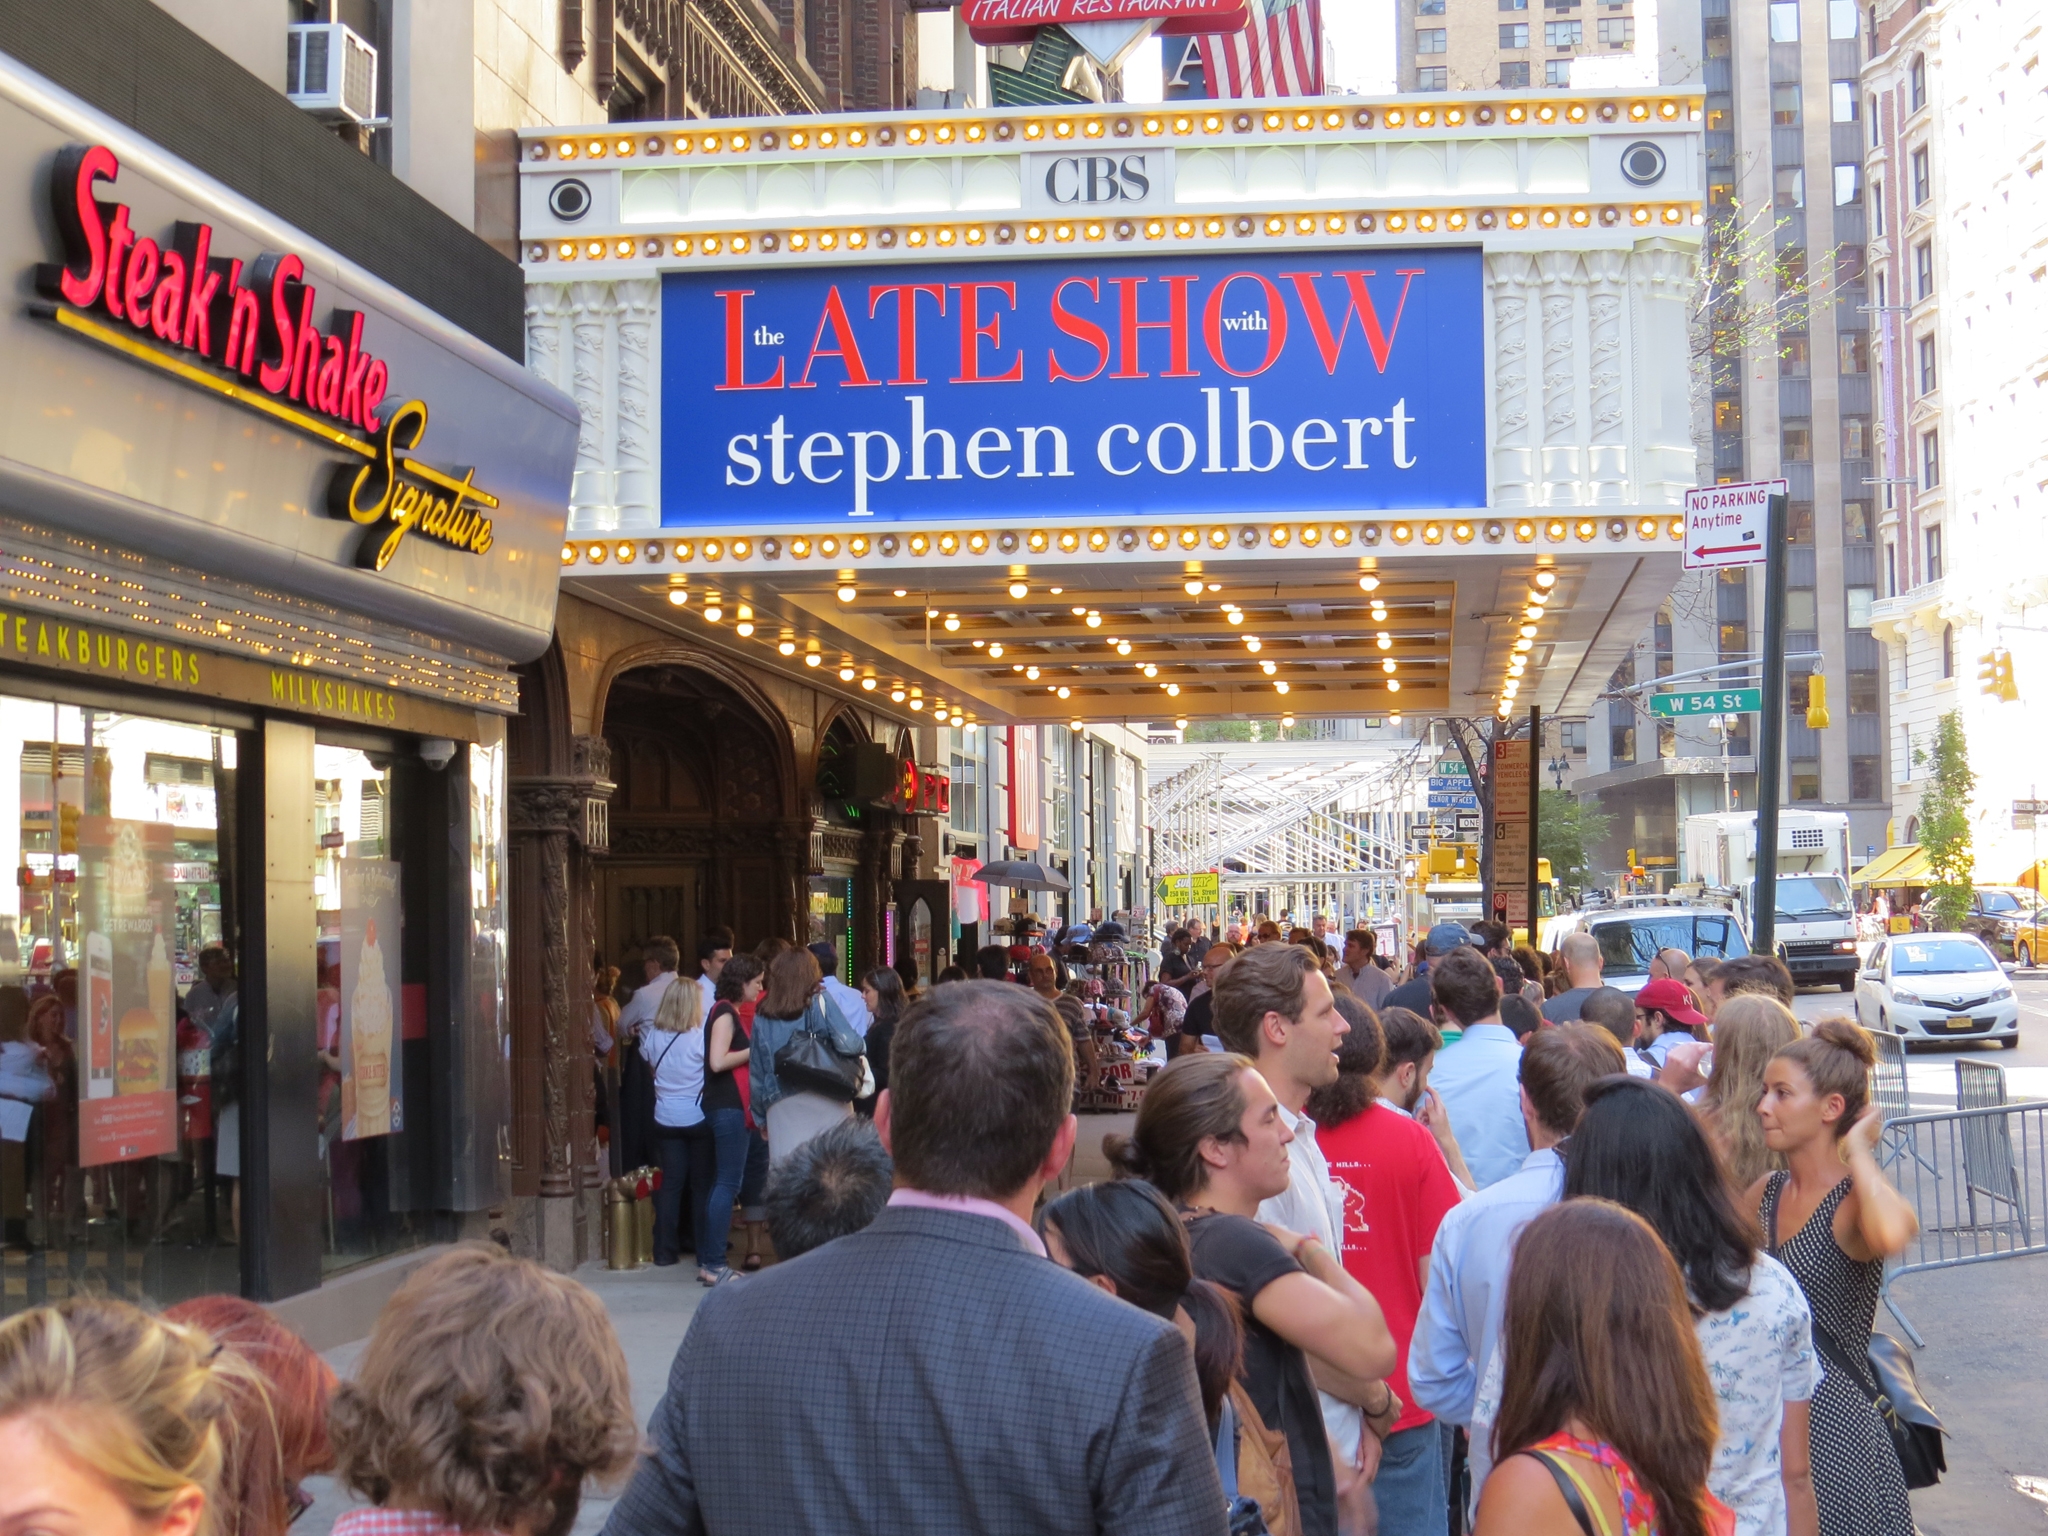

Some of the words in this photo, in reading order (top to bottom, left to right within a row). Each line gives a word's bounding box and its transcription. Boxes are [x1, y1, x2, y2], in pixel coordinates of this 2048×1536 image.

[971, 0, 1061, 21] ITALIAN
[1045, 154, 1150, 204] CBS
[61, 145, 222, 356] Steak
[260, 253, 389, 433] Shake
[714, 282, 1024, 392] LATE
[1049, 269, 1426, 384] SHOW
[1222, 310, 1268, 332] with
[753, 325, 785, 346] the
[726, 396, 1075, 517] stephen
[1098, 387, 1418, 475] colbert
[349, 399, 499, 572] Signature
[1691, 495, 1709, 512] NO
[1712, 489, 1766, 508] PARKING
[1691, 511, 1742, 531] Anytime
[271, 671, 397, 722] MILKSHAKES
[1669, 698, 1687, 712] W
[1691, 696, 1715, 710] 54
[1720, 693, 1742, 708] St
[1497, 743, 1505, 758] 3
[1440, 762, 1447, 774] W
[1449, 762, 1459, 774] 54
[1497, 762, 1530, 770] COMMERCIA
[1430, 778, 1444, 787] BIG
[1446, 778, 1473, 787] APPLE
[1463, 819, 1480, 827] ONE
[1496, 823, 1504, 839] 6
